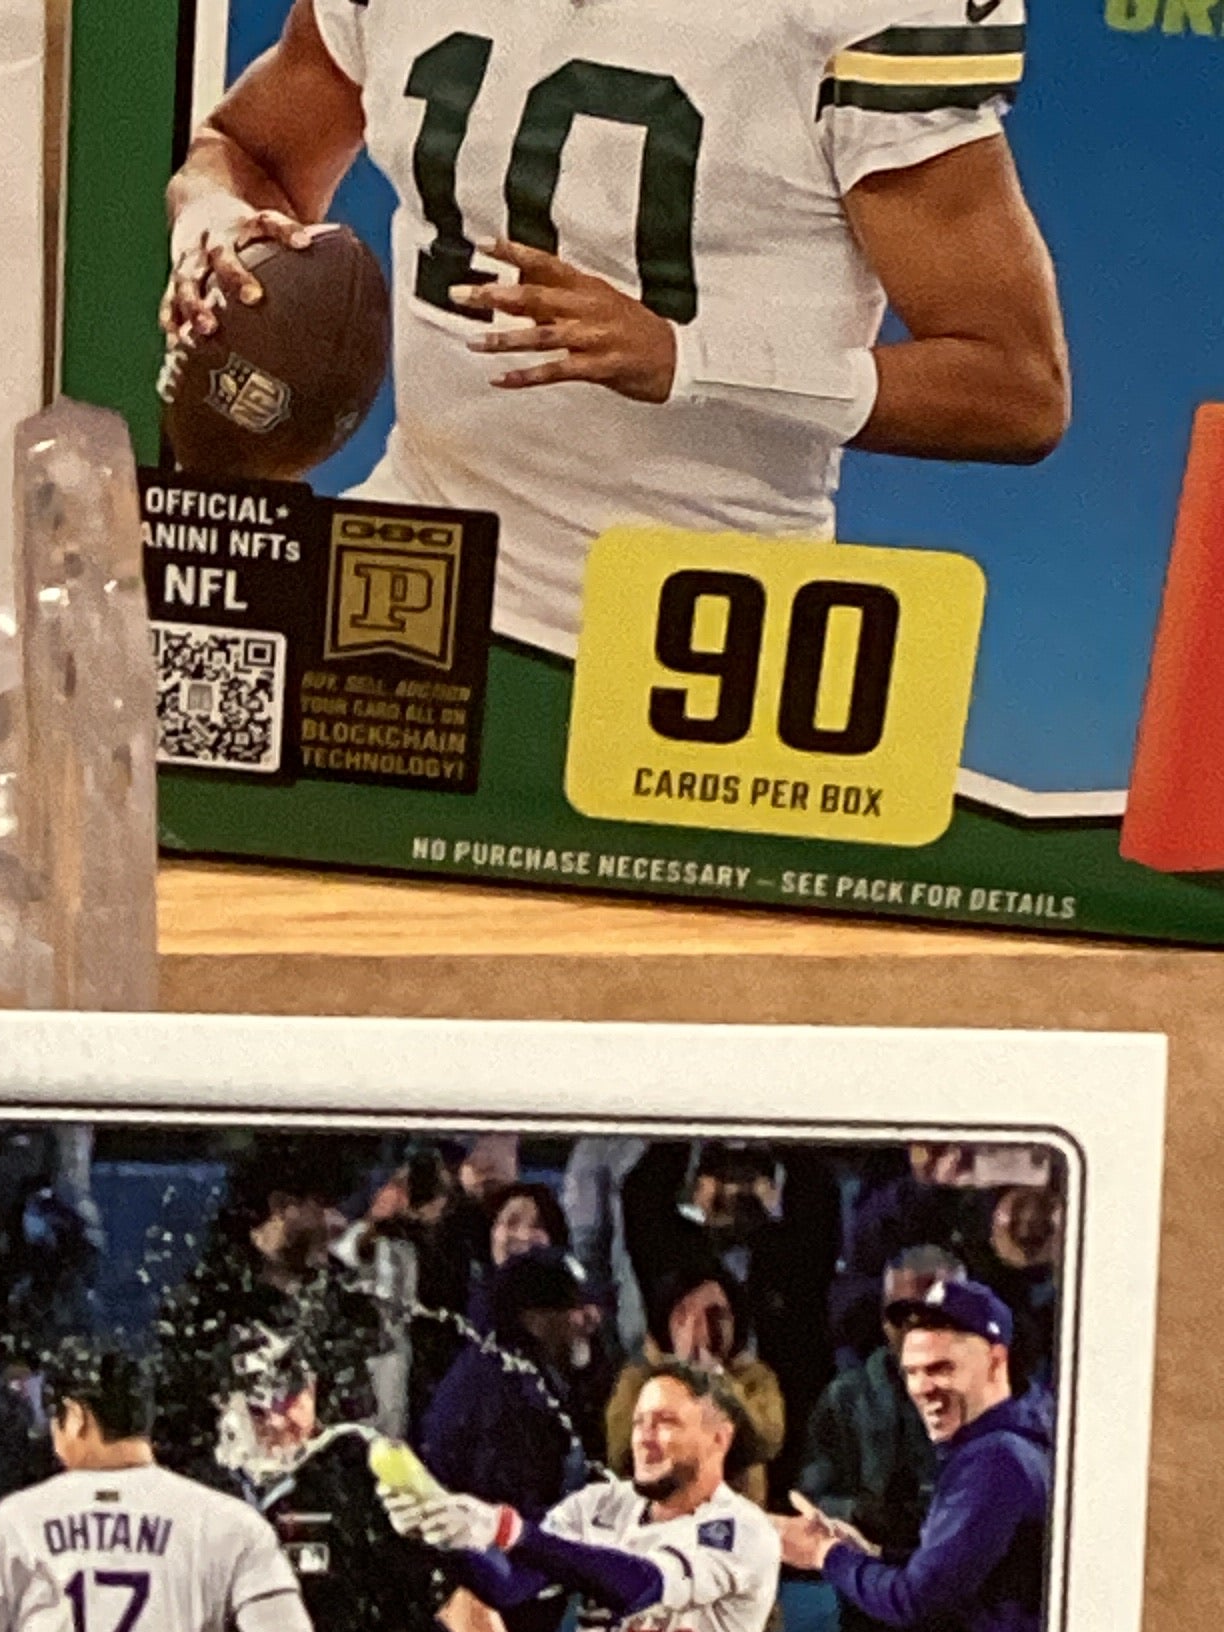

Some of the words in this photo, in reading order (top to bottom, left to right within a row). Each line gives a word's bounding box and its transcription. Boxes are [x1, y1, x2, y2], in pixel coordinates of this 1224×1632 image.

[404, 31, 703, 325] 10
[140, 520, 219, 556] ANINI
[229, 528, 301, 563] NFTs
[163, 563, 249, 611] NFL
[648, 567, 902, 757] 90
[301, 717, 467, 755] BLOCKCHAIN
[300, 745, 465, 781] TECHNOLOGY!
[633, 767, 741, 805] CARDS
[749, 776, 810, 811] PER
[820, 783, 884, 817] BOX
[412, 836, 446, 861] NO
[453, 840, 592, 876] PURCHASE
[597, 853, 751, 889] NECESSARY
[780, 870, 829, 897] SEE
[835, 875, 904, 904] PACK
[910, 882, 963, 909] FOR
[968, 887, 1076, 920] DETAILS
[43, 1511, 174, 1558] OHTANI
